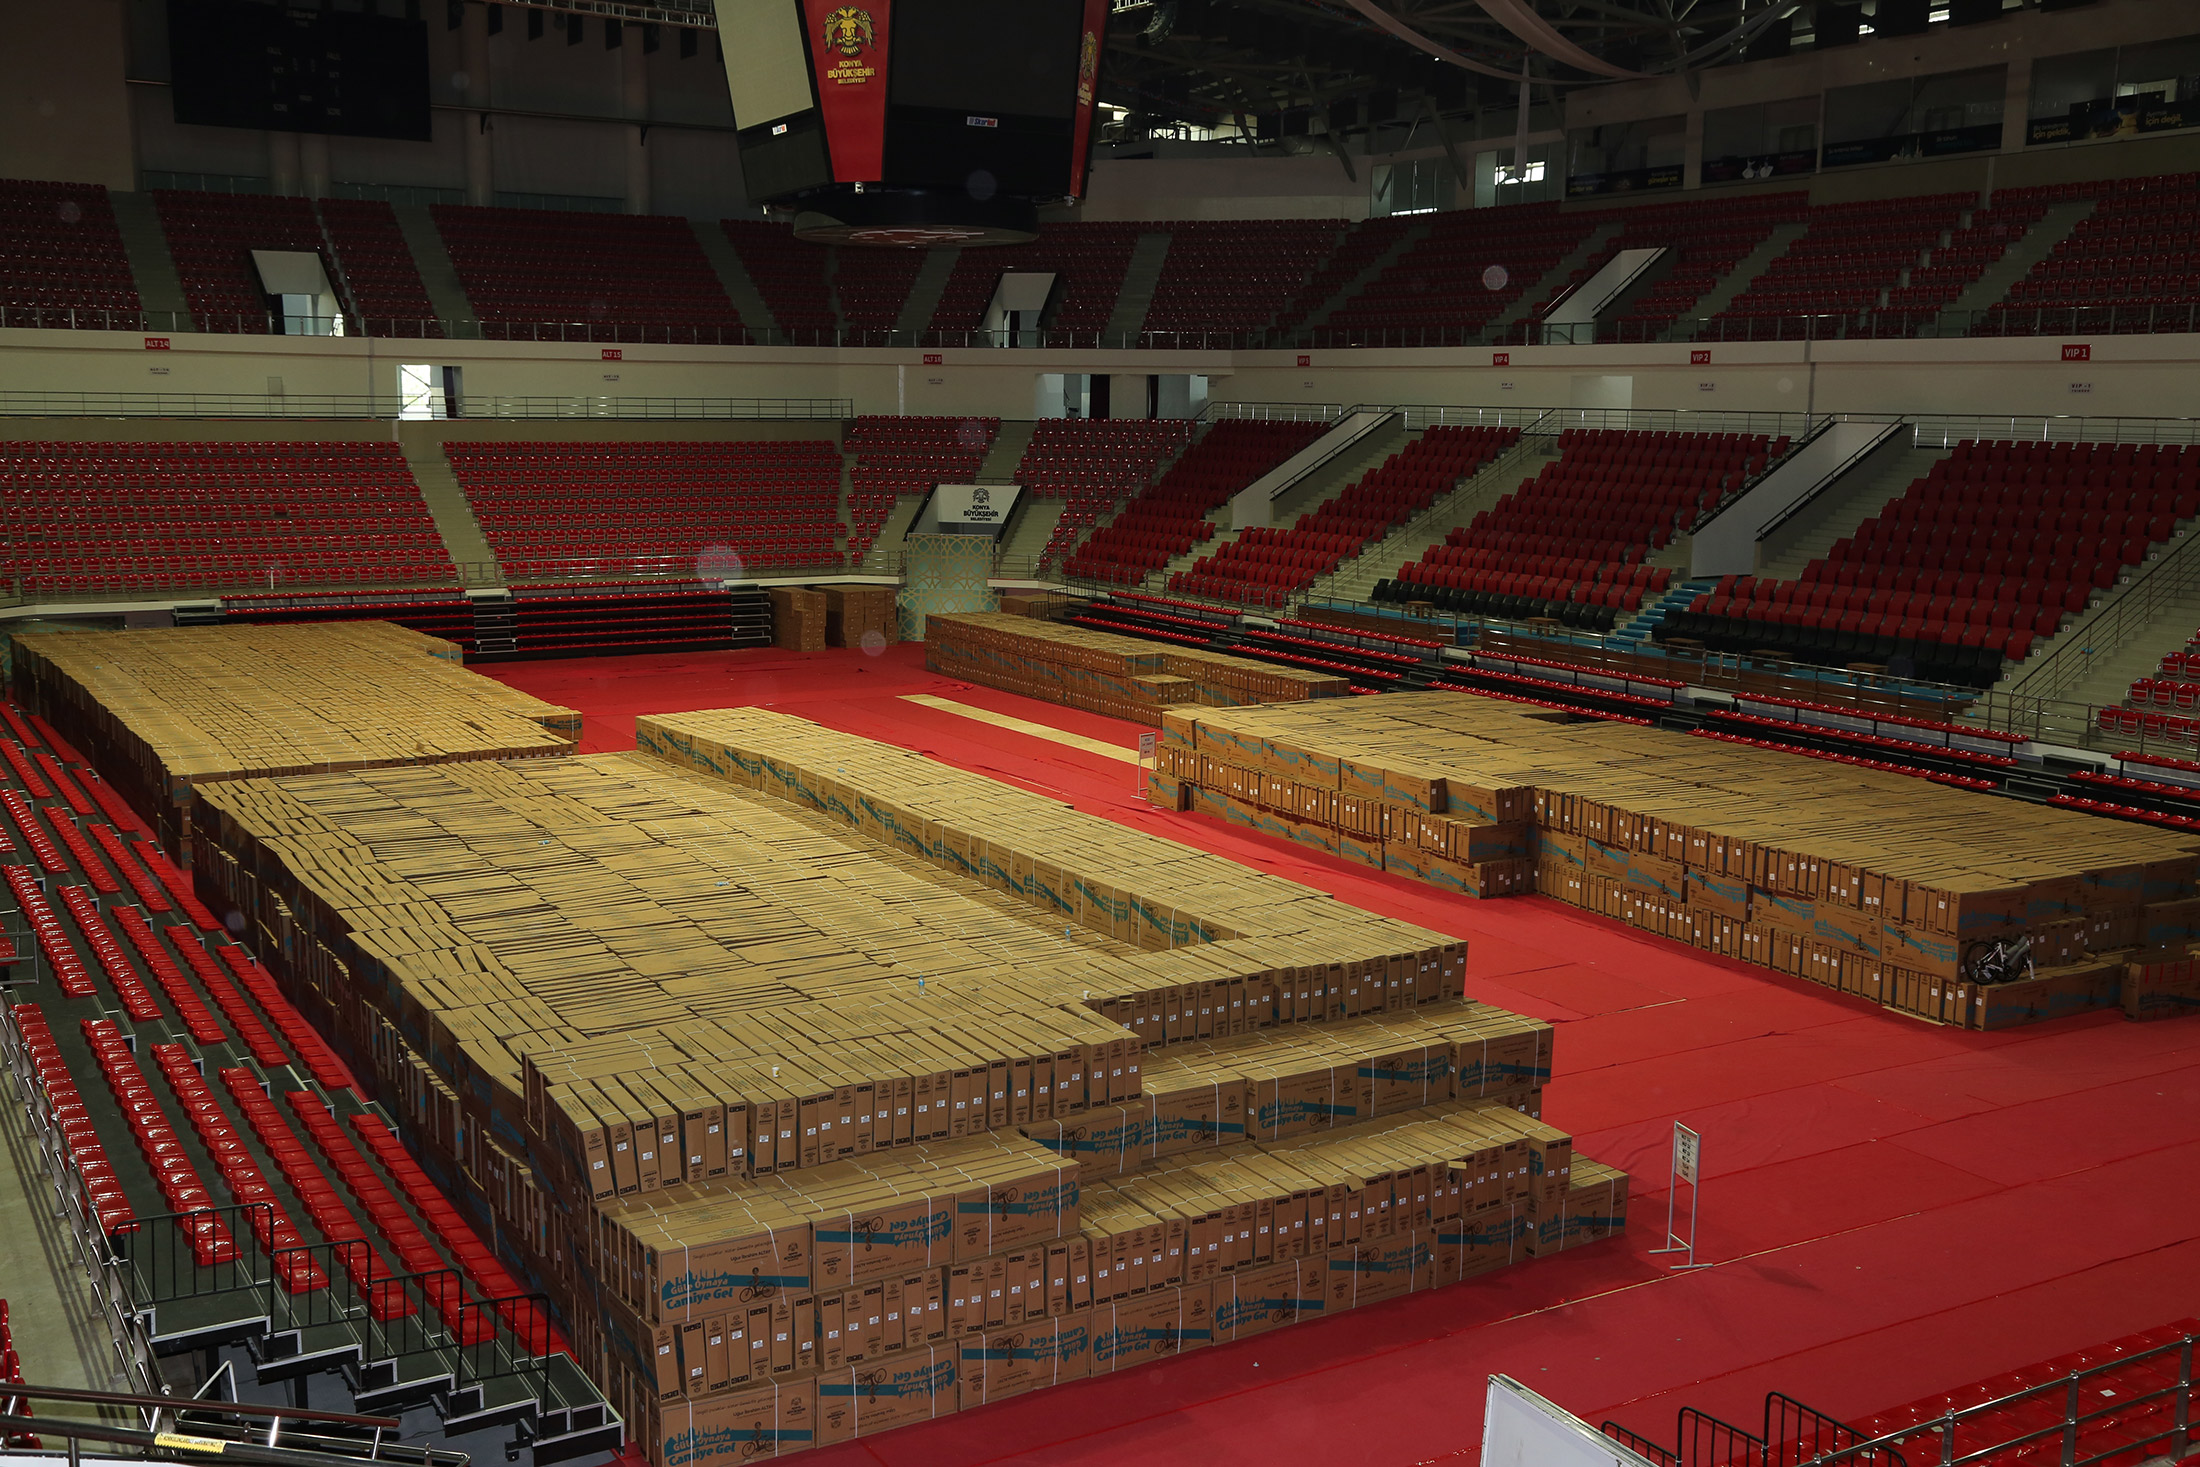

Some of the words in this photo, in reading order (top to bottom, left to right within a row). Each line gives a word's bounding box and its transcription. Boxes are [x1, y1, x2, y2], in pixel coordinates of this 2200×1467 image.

[839, 60, 863, 68] KONYA
[827, 66, 875, 79] BÜYÜKŞEHİR
[146, 340, 158, 348] ALT
[1692, 353, 1703, 361] VIP
[1704, 353, 1709, 362] 2
[2065, 348, 2080, 358] VIP
[2081, 348, 2087, 358] 1
[963, 510, 999, 518] BÜYÜKŞEHİR
[1091, 1131, 1106, 1140] Gel
[1172, 1130, 1188, 1140] Gel
[1041, 1181, 1076, 1198] Camiye
[1024, 1191, 1040, 1202] Gel
[910, 1210, 949, 1227] Camiye
[890, 1221, 908, 1232] Gel
[694, 1278, 729, 1290] Oynaya
[666, 1292, 711, 1310] Camiye
[712, 1288, 734, 1300] Gel
[1254, 1310, 1268, 1320] Gel
[1048, 1326, 1086, 1344] Camiye
[1029, 1336, 1048, 1348] Gel
[1096, 1343, 1133, 1362] Camiye
[1134, 1340, 1151, 1351] Gel
[914, 1360, 952, 1378] Camiye
[893, 1372, 912, 1383] Gel
[698, 1433, 731, 1446] Oynaya
[668, 1446, 714, 1467] Camiye
[716, 1442, 736, 1454] Gel
